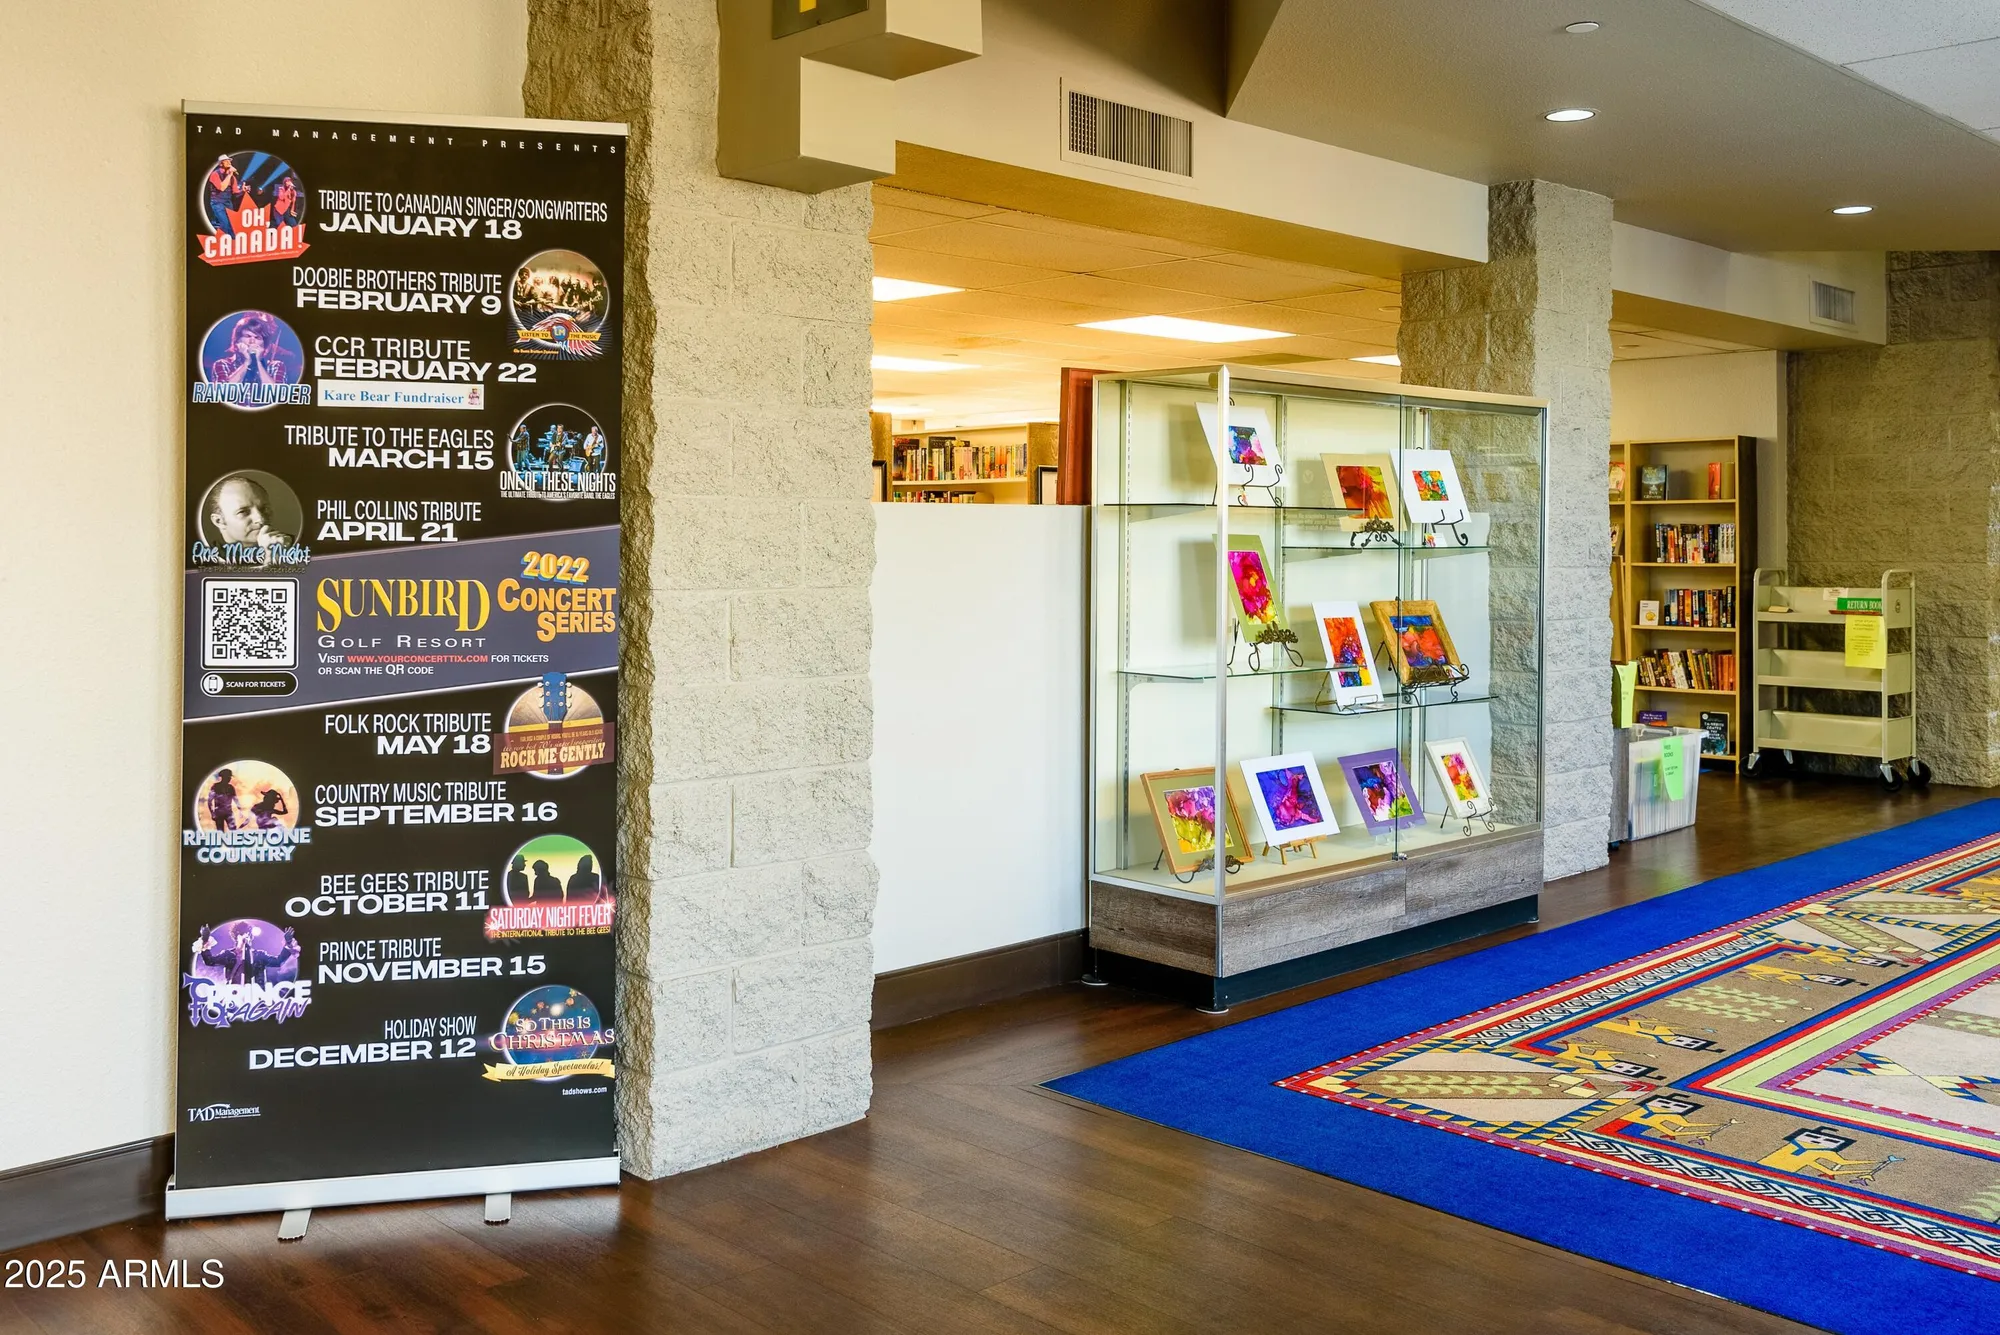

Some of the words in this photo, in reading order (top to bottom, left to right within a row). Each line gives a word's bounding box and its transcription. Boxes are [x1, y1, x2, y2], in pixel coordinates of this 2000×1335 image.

[197, 125, 242, 136] TAD
[272, 129, 454, 147] MANAGEMENT
[482, 139, 617, 154] PRESENTS
[241, 208, 271, 228] OH,
[318, 190, 373, 212] TRIBUTE
[375, 193, 394, 212] TO
[395, 194, 463, 216] CANADIAN
[465, 197, 608, 223] SINGER/SONGWRITERS
[319, 212, 476, 239] JANUARY
[484, 218, 523, 240] 18
[205, 225, 303, 258] CANADA!
[293, 266, 353, 290] DOOBIE
[356, 269, 437, 293] BROTHERS
[440, 272, 502, 295] TRIBUTE
[297, 288, 475, 315] FEBRUARY
[480, 295, 502, 316] 9
[315, 336, 367, 360] CCR
[371, 338, 470, 361] TRIBUTE
[315, 357, 491, 383] FEBRUARY
[498, 363, 537, 383] 22
[193, 381, 249, 404] RANDY
[252, 383, 311, 406] LINDER
[324, 389, 356, 401] Kare
[360, 391, 391, 402] Bear
[394, 392, 464, 404] Fundraiser
[284, 425, 362, 447] TRIBUTE
[364, 427, 387, 447] TO
[389, 427, 424, 448] THE
[428, 428, 494, 450] EAGLES
[328, 448, 450, 470] MARCH
[456, 449, 494, 470] 15
[500, 470, 522, 491] ONE
[524, 471, 538, 491] OF
[541, 471, 575, 491] THESE
[579, 472, 616, 492] NIGHTS
[317, 500, 353, 520] PHIL
[355, 500, 419, 521] COLLINS
[422, 501, 482, 522] TRIBUTE
[317, 521, 415, 542] APRIL
[421, 522, 458, 542] 21
[192, 541, 219, 564] One
[223, 542, 265, 564] More
[269, 543, 311, 565] Night
[520, 550, 590, 586] 2022
[316, 577, 490, 633] SUNBIRD
[497, 578, 617, 614] CONCERT
[1847, 600, 1868, 609] RETURN
[537, 610, 617, 642] SERIES
[318, 635, 382, 649] GOLF
[397, 634, 487, 649] RESORT
[318, 665, 333, 675] OR
[335, 665, 361, 675] SCAN
[364, 665, 383, 675] THE
[385, 664, 405, 676] QR
[407, 665, 434, 675] CODE
[347, 653, 488, 664] WWW.YOURCONCERTTIX.COM
[491, 653, 510, 664] FOR
[512, 653, 549, 664] TICKETS
[225, 680, 243, 689] SCAN
[244, 680, 258, 689] FOR
[259, 680, 286, 689] TICKETS
[325, 713, 370, 735] FOLK
[373, 713, 421, 733] ROCK
[423, 712, 491, 733] TRIBUTE
[377, 735, 451, 756] MAY
[457, 734, 491, 754] 18
[500, 749, 536, 768] ROCK
[538, 747, 557, 765] ME
[559, 742, 606, 763] GENTLY
[315, 784, 390, 804] COUNTRY
[393, 782, 443, 802] MUSIC
[444, 781, 506, 800] TRIBUTE
[314, 804, 514, 827] SEPTEMBER
[521, 802, 558, 822] 16
[183, 827, 311, 847] RHINESTONE
[197, 845, 297, 863] COUNTRY
[320, 874, 356, 895] BEE
[360, 872, 409, 893] GEES
[413, 870, 489, 892] TRIBUTE
[285, 893, 448, 918] OCTOBER
[455, 891, 489, 912] 11
[490, 906, 545, 930] SATURDAY
[546, 905, 578, 928] NIGHT
[579, 904, 612, 926] FEVER
[502, 929, 543, 938] INTERNATIONAL
[545, 928, 565, 937] TRIBUTE
[586, 927, 596, 935] BEE
[320, 940, 376, 962] PRINCE
[379, 937, 441, 960] TRIBUTE
[318, 957, 502, 984] NOVEMBER
[509, 955, 546, 975] 15
[230, 998, 310, 1024] AGAIN
[515, 1018, 537, 1032] SO
[538, 1017, 575, 1031] THIS
[577, 1015, 591, 1029] IS
[384, 1017, 436, 1040] HOLIDAY
[439, 1015, 477, 1037] SHOW
[488, 1028, 615, 1051] CHRISTMAS
[249, 1042, 433, 1071] DECEMBER
[439, 1038, 476, 1059] 12
[518, 1065, 550, 1077] Holiday
[551, 1061, 605, 1076] Spectacular!
[562, 1086, 608, 1096] tadshows.com
[187, 1106, 215, 1122] TAD
[215, 1106, 260, 1117] Management
